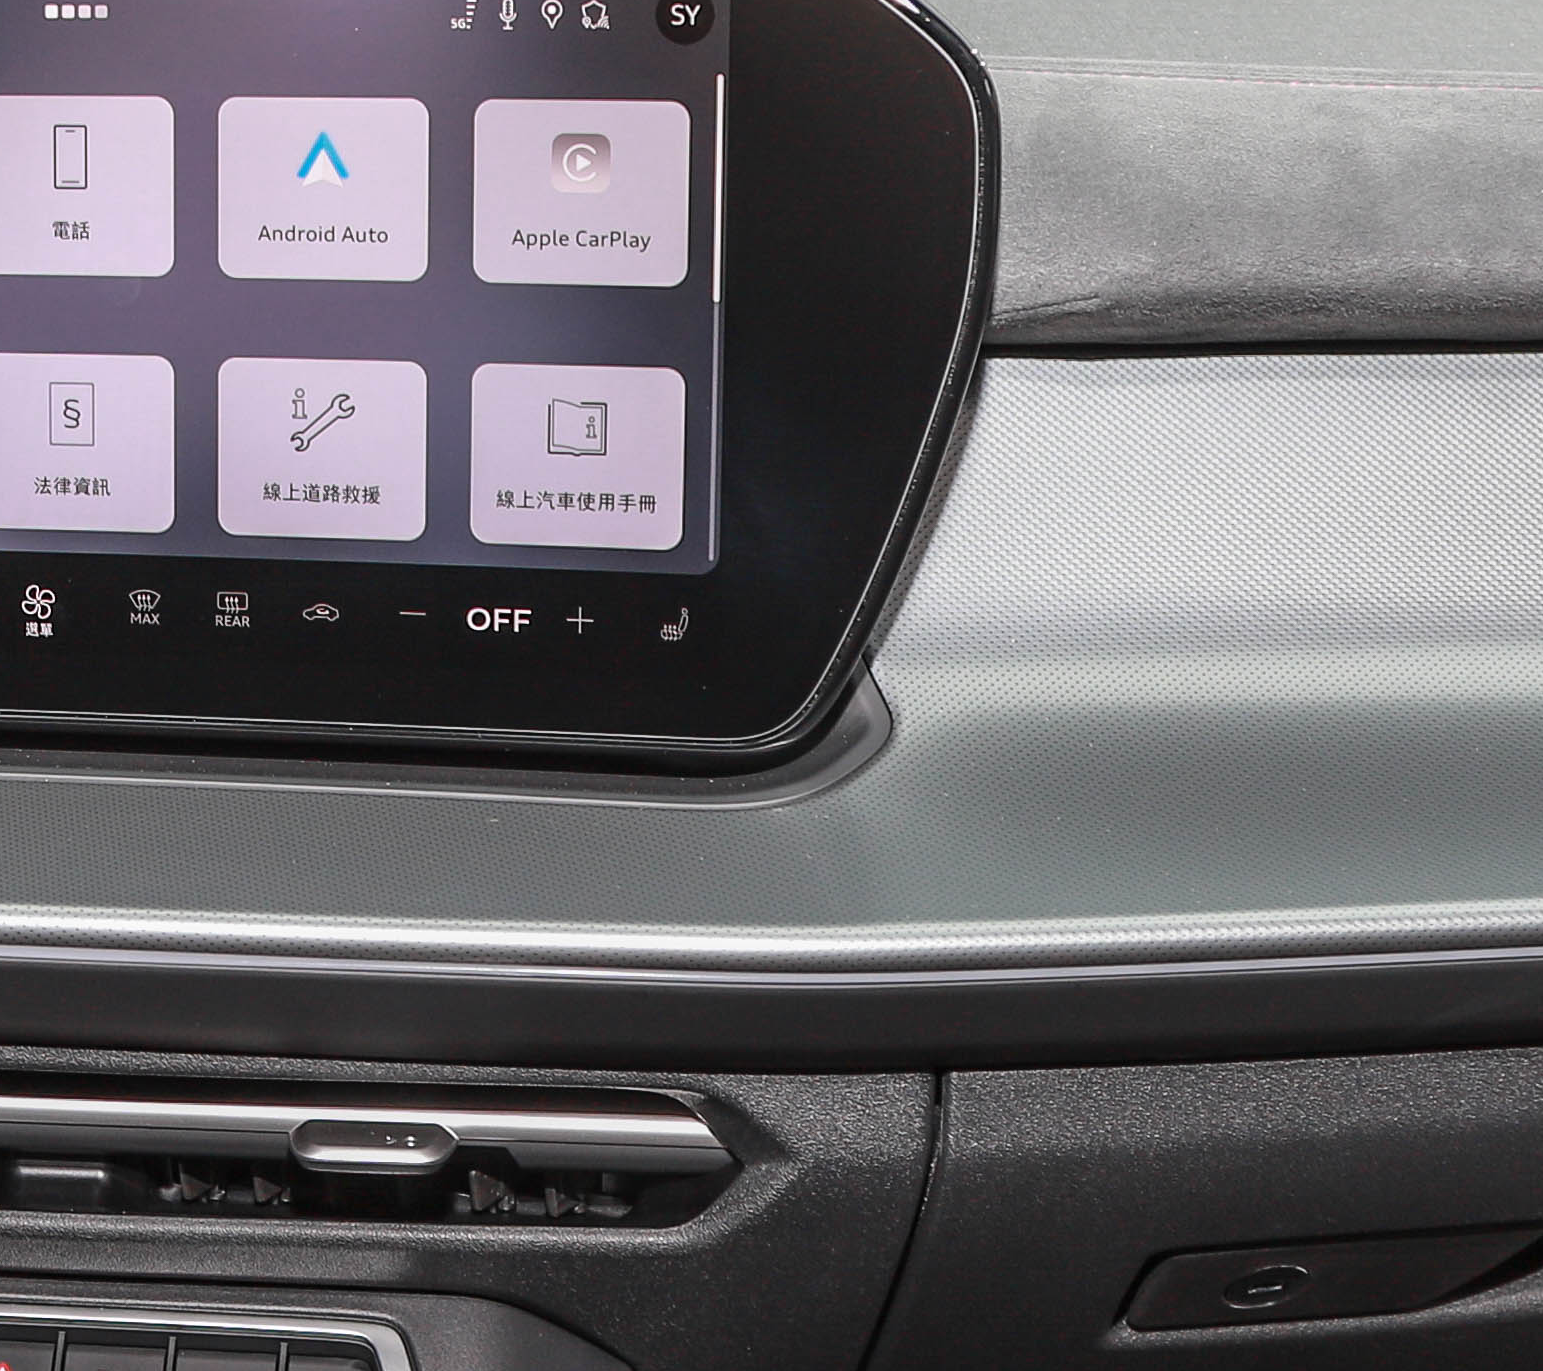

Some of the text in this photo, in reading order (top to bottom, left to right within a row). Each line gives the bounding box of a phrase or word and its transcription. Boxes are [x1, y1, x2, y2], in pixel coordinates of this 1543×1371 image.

[670, 4, 701, 26] SY
[51, 220, 90, 242] 電話
[258, 224, 389, 245] Android Auto
[511, 228, 652, 253] Apple CarPlay
[33, 475, 112, 498] 法律資訊
[262, 482, 382, 506] 線上道路救援
[495, 488, 658, 514] 線上汽車使用手冊
[130, 612, 161, 626] MAX
[215, 613, 251, 628] REAR
[466, 607, 533, 634] OFF
